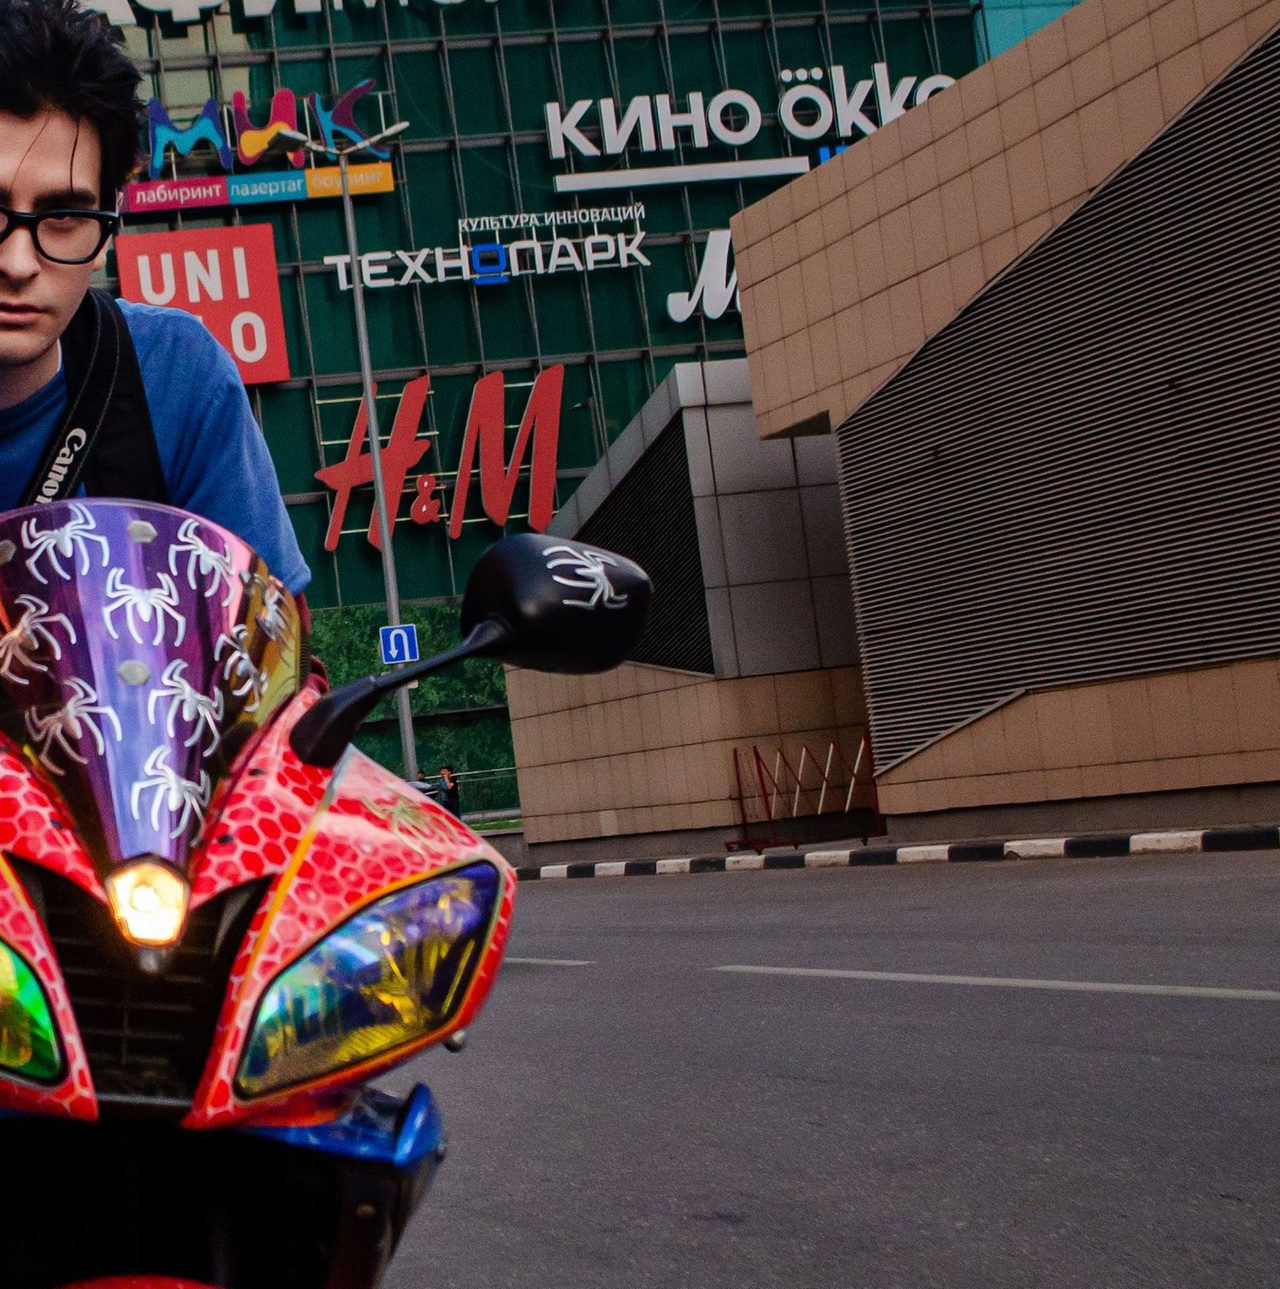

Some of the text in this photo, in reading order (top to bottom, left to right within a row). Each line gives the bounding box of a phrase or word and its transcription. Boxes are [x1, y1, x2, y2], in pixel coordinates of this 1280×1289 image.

[545, 88, 762, 160] КИНО
[135, 184, 222, 205] лабиринт
[457, 202, 646, 233] КУЛЬТУРА ИННОВАЦИЙ
[137, 246, 250, 306] UNI
[323, 230, 652, 292] ТЕХНОПАРК
[315, 364, 565, 552] H&M
